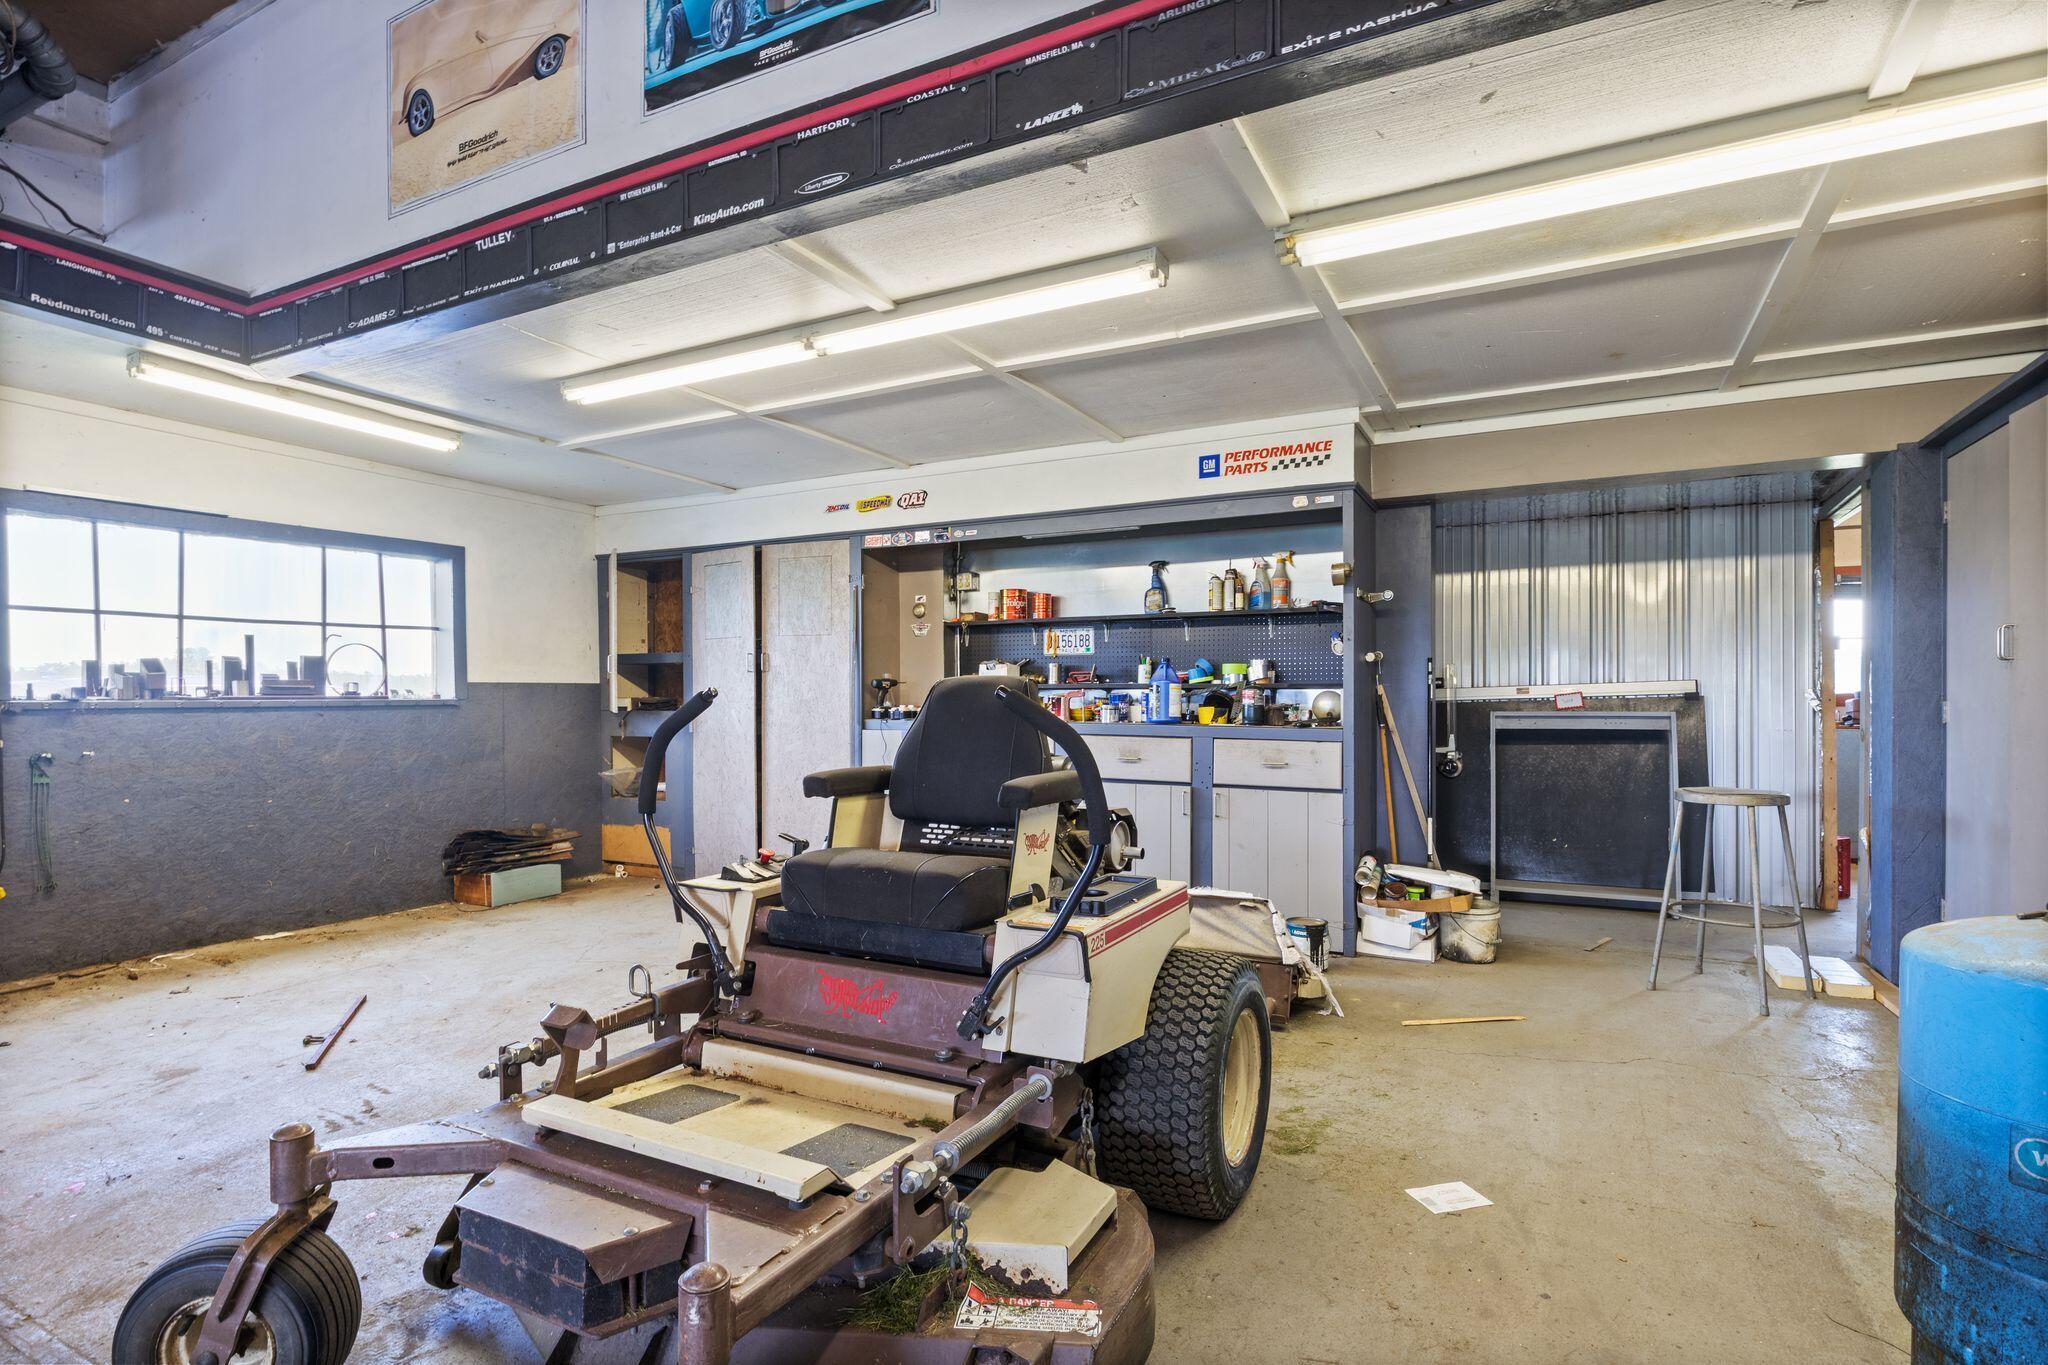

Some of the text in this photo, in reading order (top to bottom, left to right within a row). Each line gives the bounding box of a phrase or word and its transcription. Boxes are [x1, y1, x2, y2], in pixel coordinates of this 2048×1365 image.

[1281, 1, 1438, 54] EXIT 2 NASHUA
[1025, 41, 1083, 65] MANSFIELD, MA
[906, 84, 955, 103] COASTAL
[797, 117, 850, 139] HARTFORD
[459, 130, 498, 152] BFGoodrich
[889, 142, 974, 170] CoastalNissan.com
[693, 198, 764, 226] KingAuto.com
[475, 230, 512, 251] TULLEY
[620, 225, 682, 249] Enterprise Rent-A-Car
[549, 256, 581, 271] COLONIAL
[490, 275, 525, 289] NASHUA
[31, 293, 136, 329] ReedmanToll.com
[357, 311, 387, 328] ADAMS
[146, 325, 164, 337] 495
[1224, 440, 1333, 463] PERFORMANCE
[1203, 459, 1216, 470] GM
[1224, 461, 1268, 477] PARTS
[901, 492, 925, 507] QA1
[1090, 933, 1105, 953] 225
